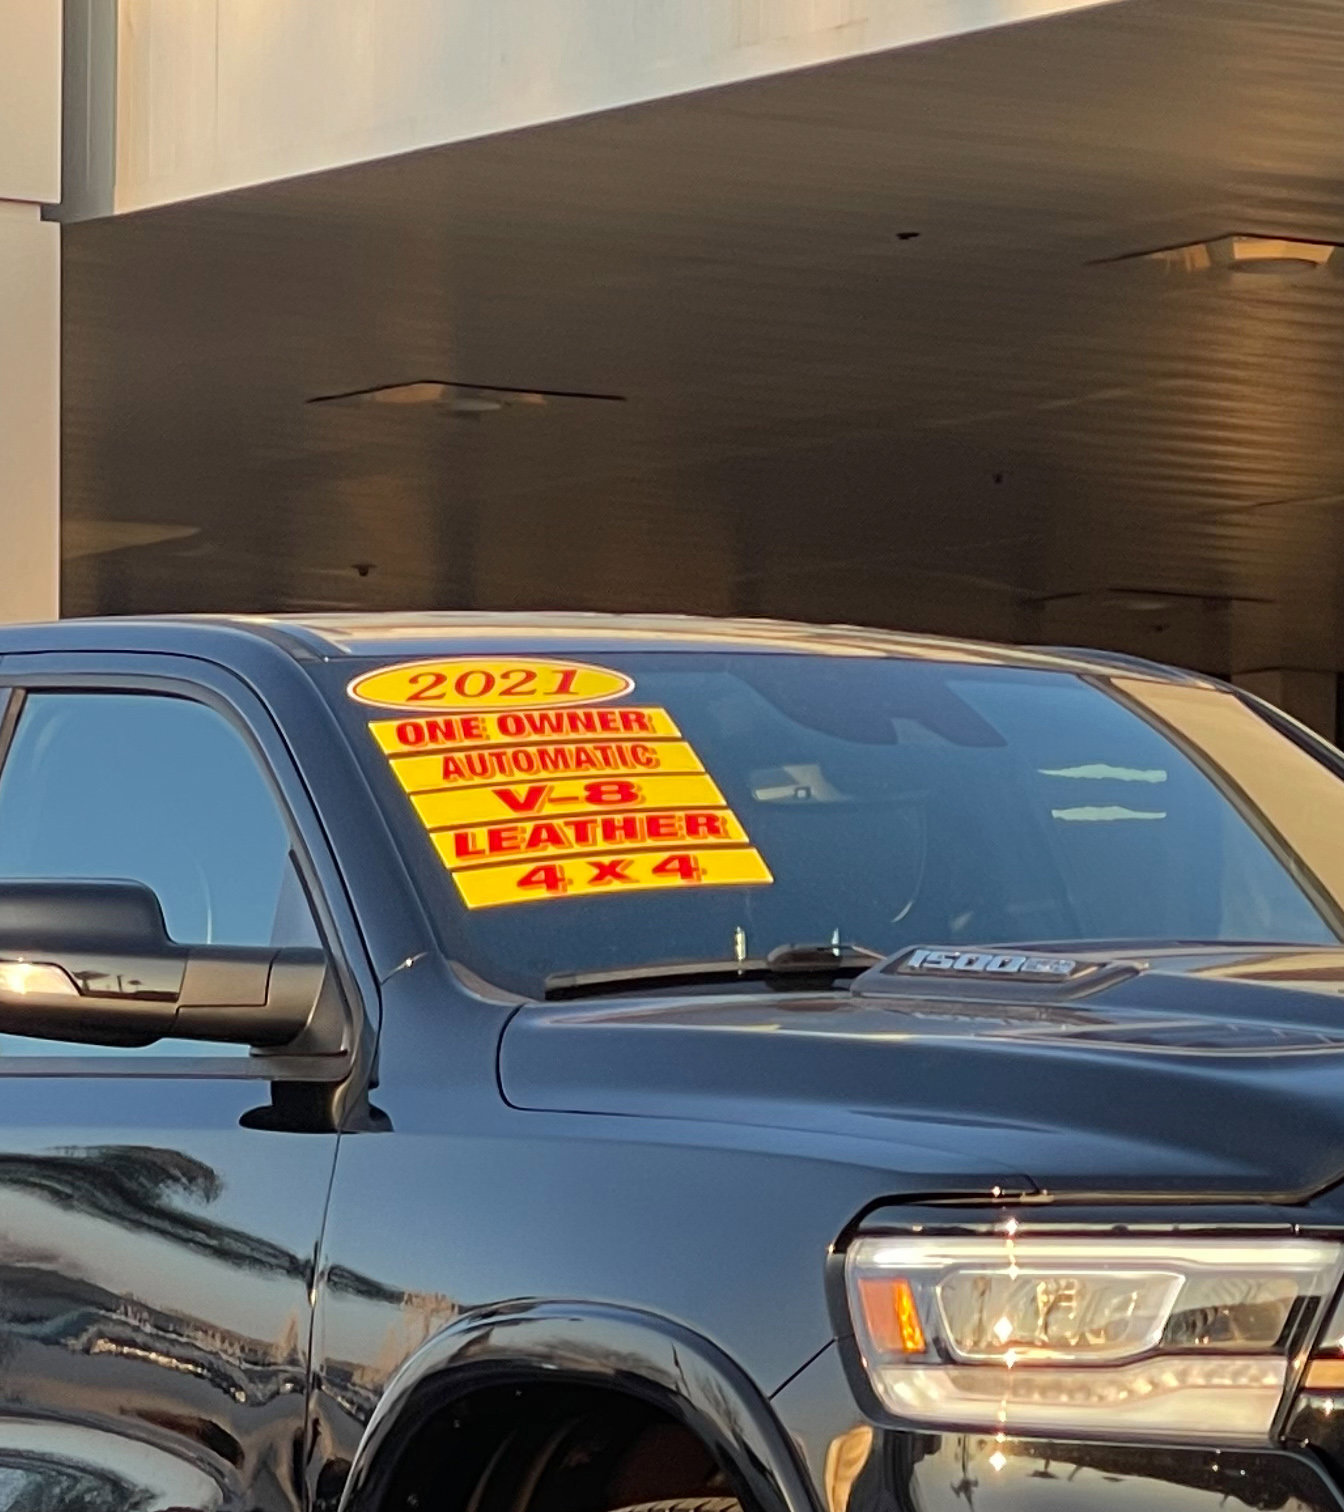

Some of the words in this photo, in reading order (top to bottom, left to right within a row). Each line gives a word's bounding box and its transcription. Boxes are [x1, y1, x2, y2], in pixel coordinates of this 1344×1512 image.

[405, 668, 580, 703] 2021
[396, 715, 490, 748] ONE
[497, 709, 654, 739] OWNER
[442, 743, 661, 782] AUTOMATIC
[492, 780, 642, 814] V-8
[454, 811, 730, 859] LEATHER
